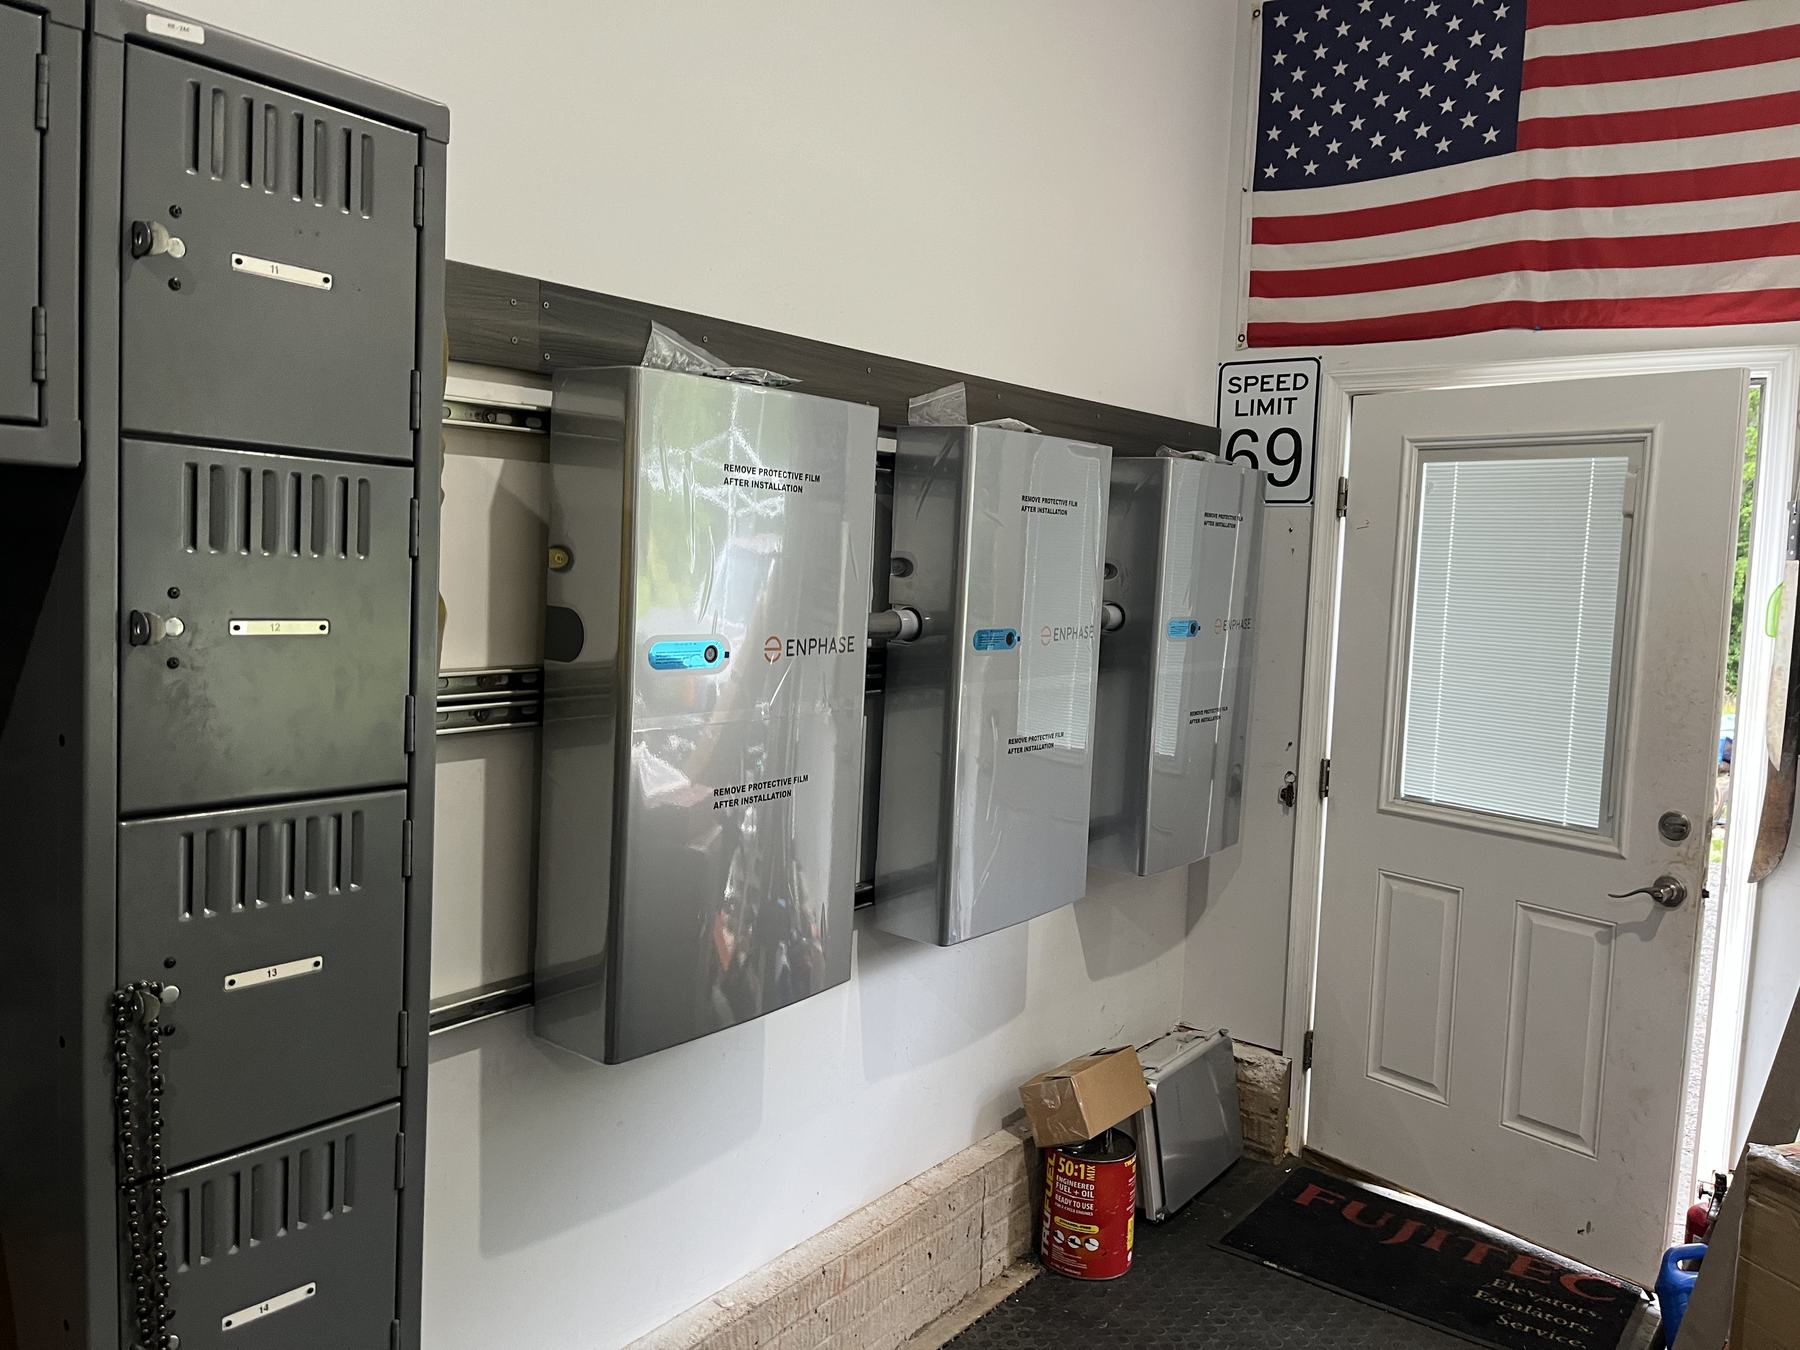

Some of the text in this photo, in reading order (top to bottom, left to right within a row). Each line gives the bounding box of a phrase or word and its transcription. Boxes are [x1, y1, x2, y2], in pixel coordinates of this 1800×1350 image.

[270, 264, 279, 275] 11
[1227, 373, 1309, 394] SPEED
[1234, 397, 1298, 417] LIMIT
[1225, 427, 1302, 487] 69
[724, 463, 821, 483] REMOVE PROTECTIVE FILM
[723, 477, 803, 494] AFTER INSTALLATION
[1021, 494, 1041, 504] REMOVE
[1041, 497, 1068, 506] PROTECTIVE
[1021, 505, 1068, 515] AFTER INSTALLATION
[270, 623, 281, 632] 12
[1053, 625, 1094, 641] ENPHASE
[786, 636, 855, 657] ENPHASE
[1008, 736, 1028, 745] REMOVE
[1028, 733, 1055, 742] PROTECTIVE
[1007, 743, 1054, 755] AFTER INSTALLATION
[713, 774, 809, 797] REMOVE PROTECTIVE FILM
[713, 790, 792, 810] AFTER INSTALLATION
[267, 968, 278, 978] 13
[1057, 1157, 1085, 1180] 50:1
[1086, 1164, 1096, 1181] MIX
[1055, 1182, 1072, 1194] FUEL
[1081, 1190, 1095, 1198] OIL
[1056, 1174, 1095, 1191] ENGINEERED
[1055, 1194, 1072, 1206] READY
[1072, 1200, 1081, 1209] TO
[1081, 1203, 1094, 1211] USE
[1295, 1183, 1622, 1301] FUJITEC
[259, 1303, 269, 1314] 14
